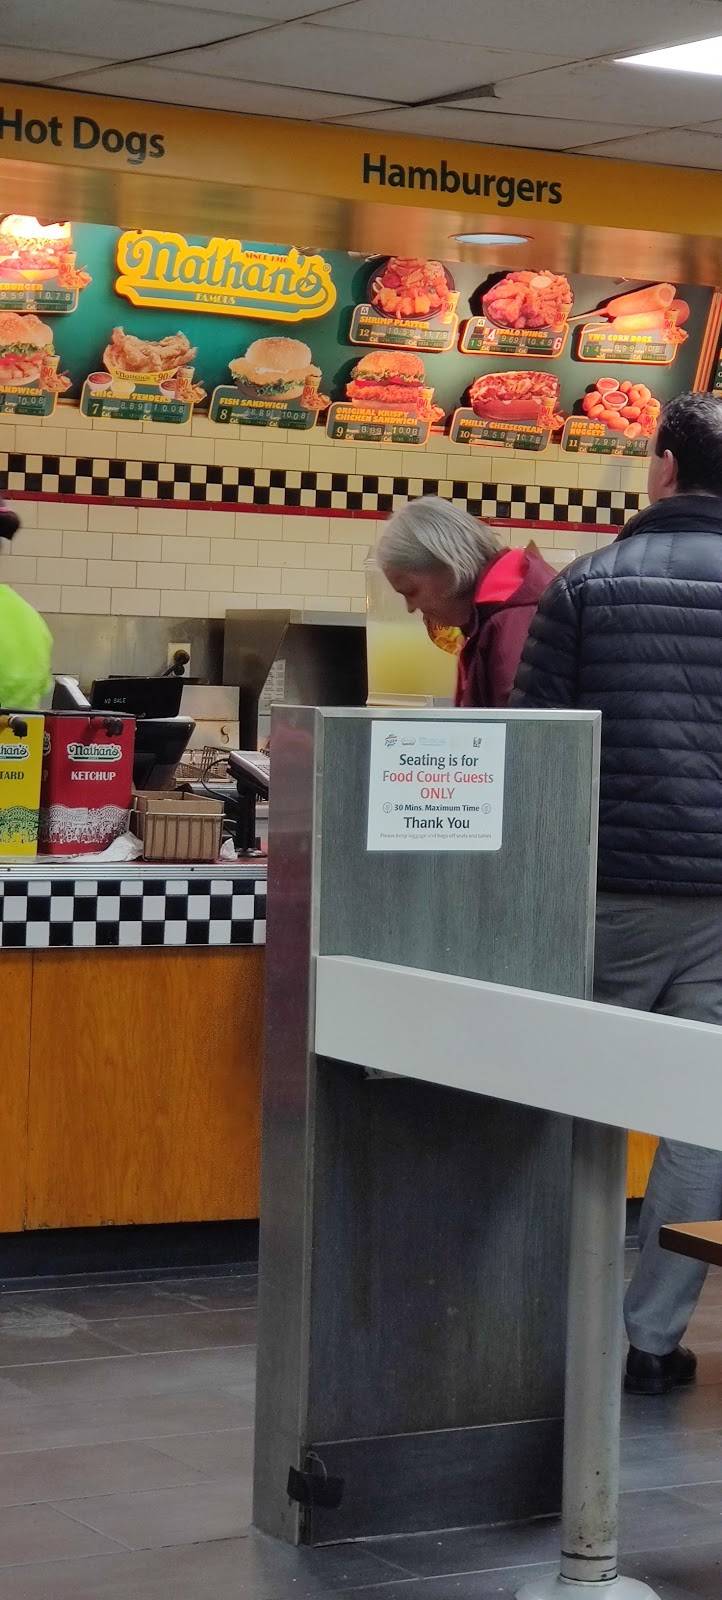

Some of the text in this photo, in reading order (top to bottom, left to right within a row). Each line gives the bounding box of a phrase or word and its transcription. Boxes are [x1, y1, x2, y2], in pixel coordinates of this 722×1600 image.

[0, 106, 166, 165] Hot Dogs
[362, 152, 563, 208] Hamburgers
[126, 235, 323, 298] Nathan's
[92, 403, 100, 415] 7
[240, 400, 288, 410] SANDWICH
[220, 409, 228, 420] 8
[335, 414, 417, 426] CHICKEN SANDWICH
[337, 426, 344, 437] 9
[459, 419, 543, 433] PHILLY CHEESESTEAK
[460, 431, 470, 439] 10
[570, 429, 606, 437] NUGGETS
[69, 744, 120, 757] Nathan's
[399, 753, 479, 770] Seating is for
[71, 770, 117, 781] KETCHUP
[382, 770, 494, 784] Food Court Guests
[420, 787, 455, 800] ONLY
[403, 816, 470, 829] Thank You
